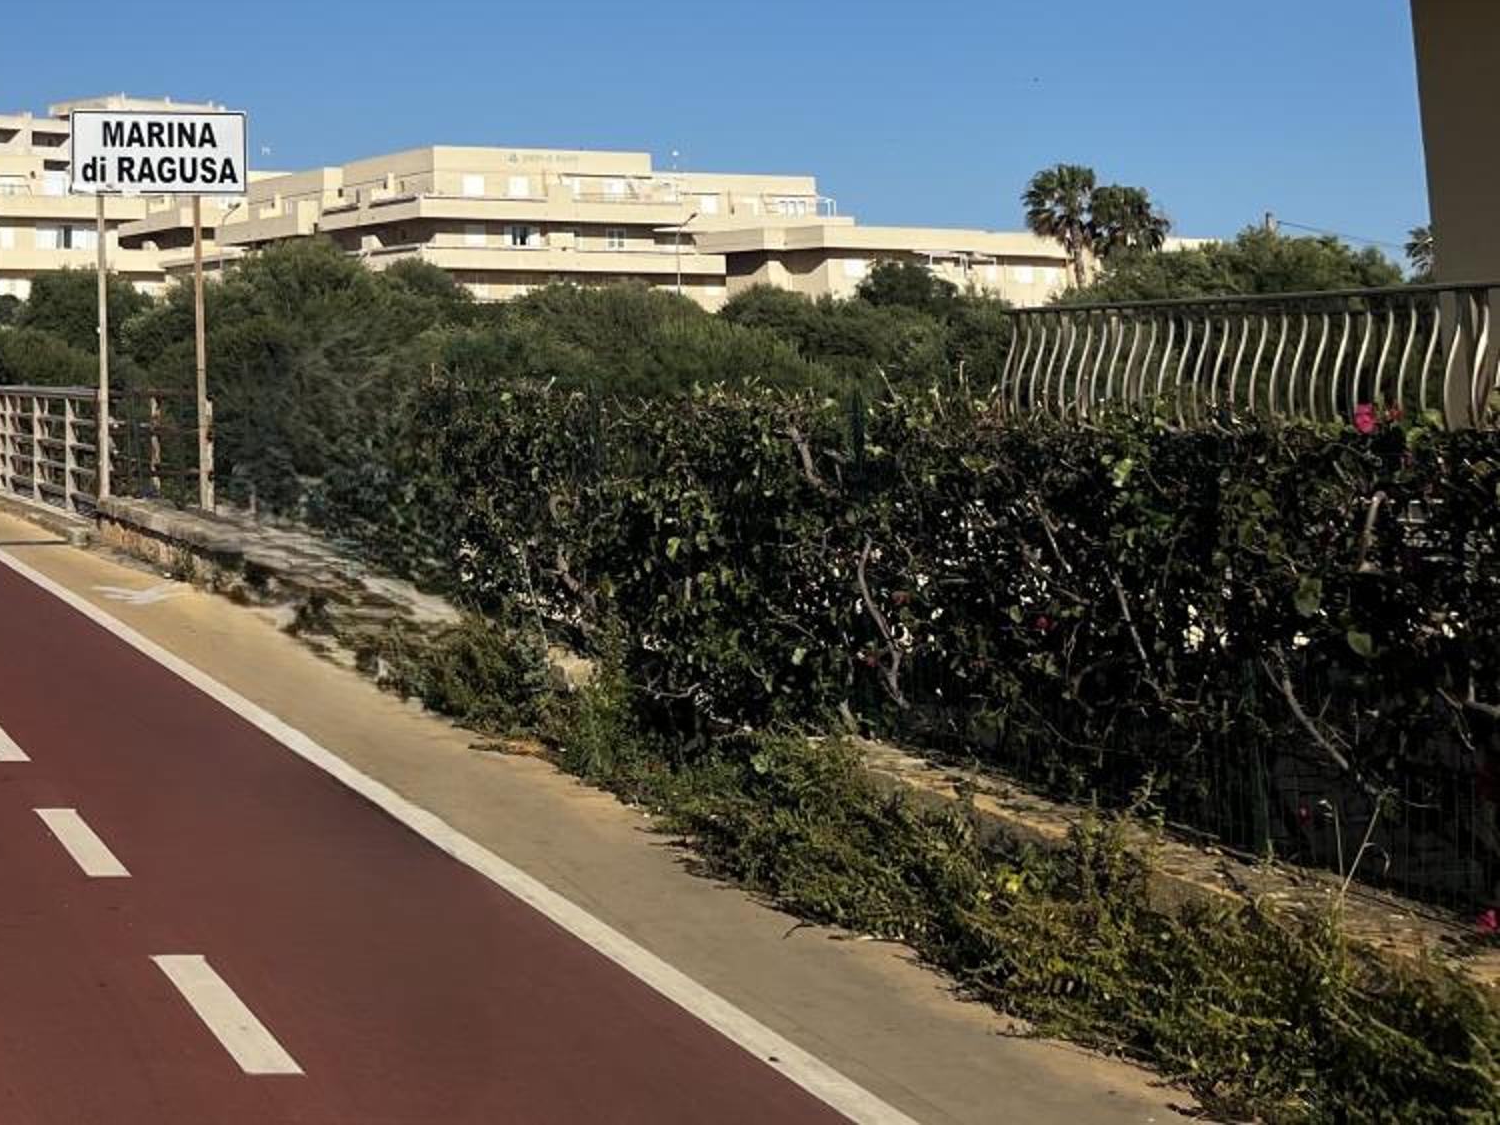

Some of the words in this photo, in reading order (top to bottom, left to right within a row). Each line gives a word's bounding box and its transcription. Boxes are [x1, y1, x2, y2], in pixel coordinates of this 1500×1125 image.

[102, 121, 217, 148] MARINA
[81, 156, 106, 183] di
[117, 156, 238, 184] RAGUSA
